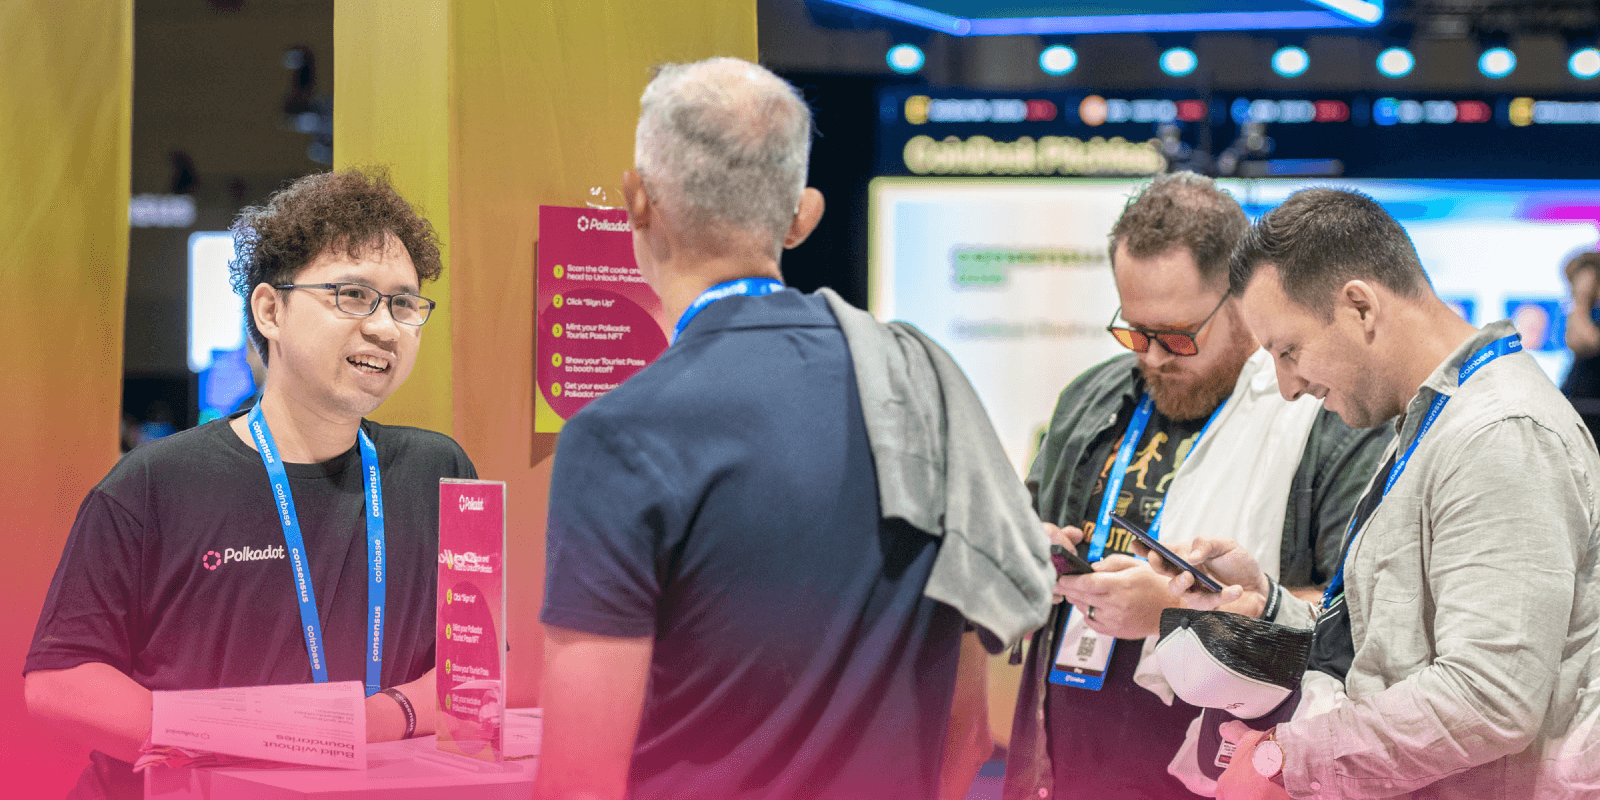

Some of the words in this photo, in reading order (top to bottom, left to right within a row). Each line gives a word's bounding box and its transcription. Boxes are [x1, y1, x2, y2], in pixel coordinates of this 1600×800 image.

[567, 264, 584, 272] Scan
[585, 265, 597, 273] the
[598, 265, 609, 274] QR
[609, 266, 628, 274] code
[567, 272, 584, 280] head
[593, 274, 617, 282] Unlock
[566, 297, 582, 305] Click
[566, 323, 582, 331] Mint
[598, 324, 630, 332] Polkadot
[566, 331, 588, 339] Tourist
[589, 332, 607, 340] Pass
[608, 332, 623, 340] NFT
[565, 356, 584, 364] Show
[600, 357, 625, 365] Tourist
[626, 358, 645, 366] Pass
[573, 365, 593, 373] booth
[594, 365, 613, 373] staff
[1459, 349, 1495, 379] coinbase
[564, 390, 594, 398] Polkadot
[1417, 394, 1447, 443] consensus
[252, 421, 274, 464] consensus
[369, 465, 379, 518] consensus
[275, 483, 291, 526] coinbase
[224, 545, 285, 564] Polkadot
[373, 539, 382, 583] coinbase
[292, 548, 309, 603] consensus
[372, 606, 381, 662] consensus
[307, 625, 321, 670] coinbase
[263, 740, 318, 754] without
[276, 734, 355, 750] boundaries
[321, 748, 354, 759] Build
